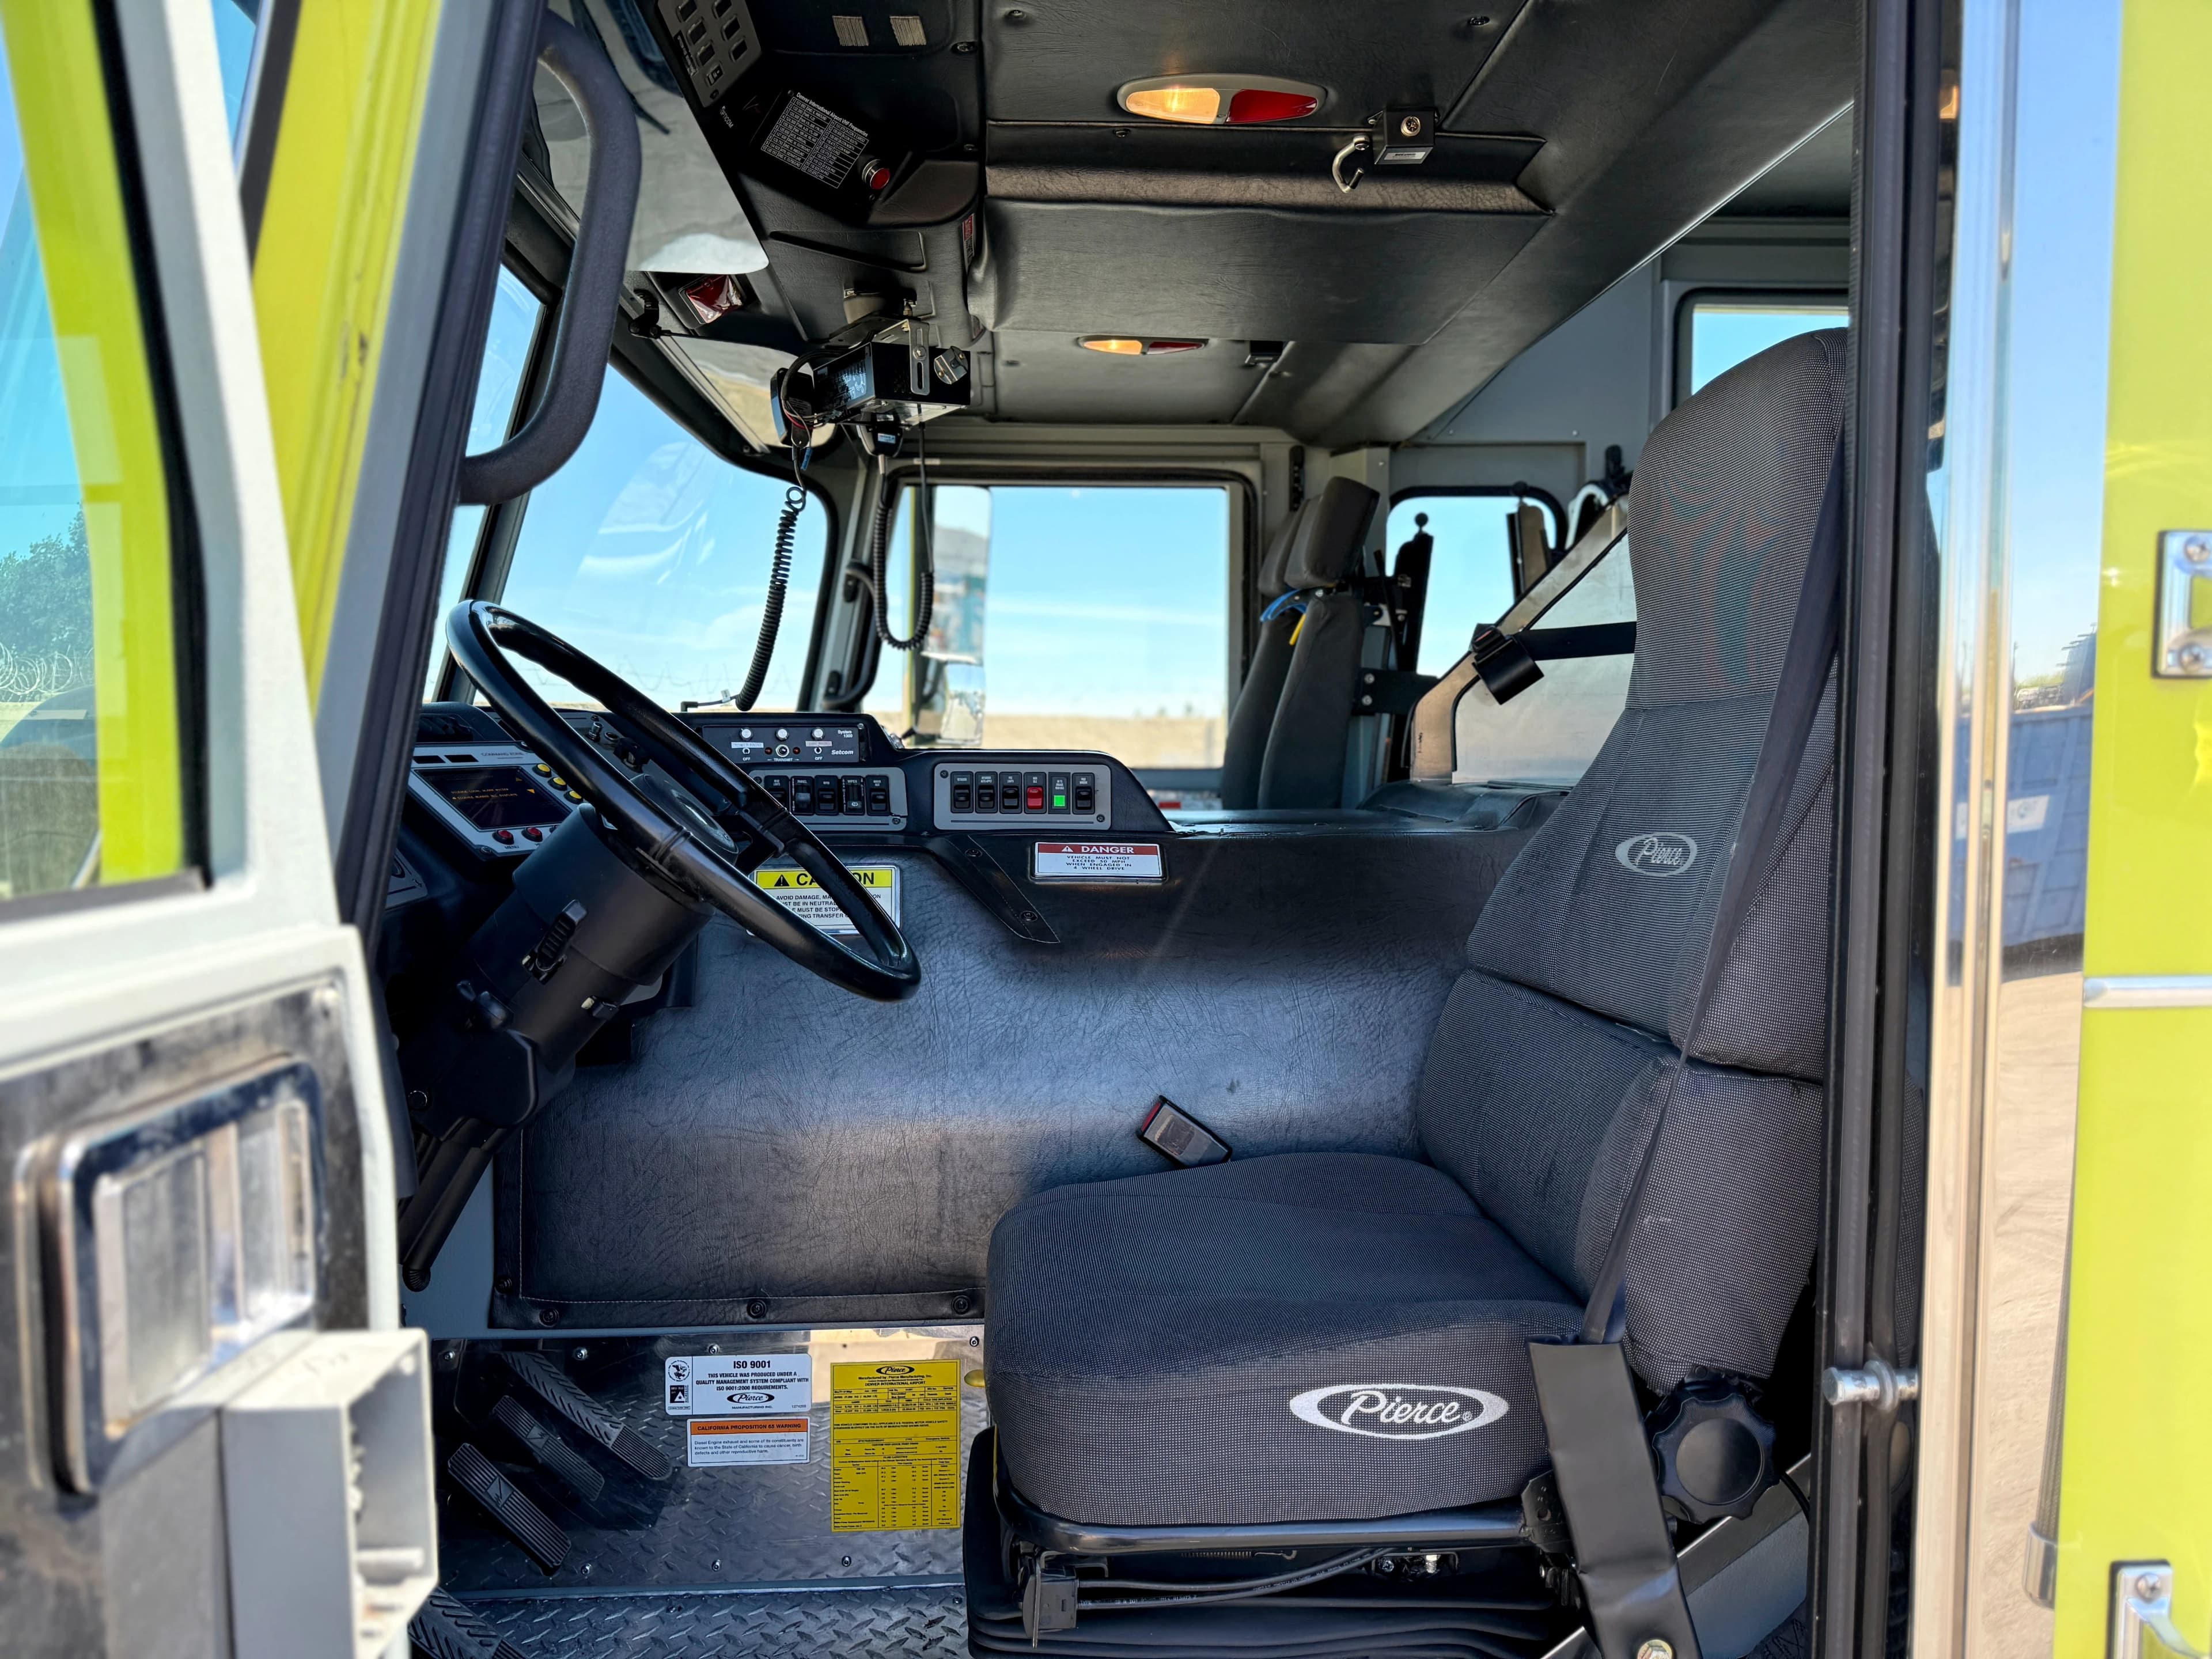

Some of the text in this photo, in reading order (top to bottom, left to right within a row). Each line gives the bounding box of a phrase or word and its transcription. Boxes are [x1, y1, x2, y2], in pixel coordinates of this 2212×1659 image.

[720, 109, 734, 128] OPTICOM
[797, 92, 809, 103] Denver
[809, 100, 831, 115] International
[830, 112, 842, 122] Airport
[849, 123, 868, 137] Frequencies
[1635, 838, 1682, 865] Pierce
[733, 1360, 771, 1369] ISO 9001
[738, 1393, 764, 1403] Pierce
[1341, 1391, 1461, 1425] Pierce
